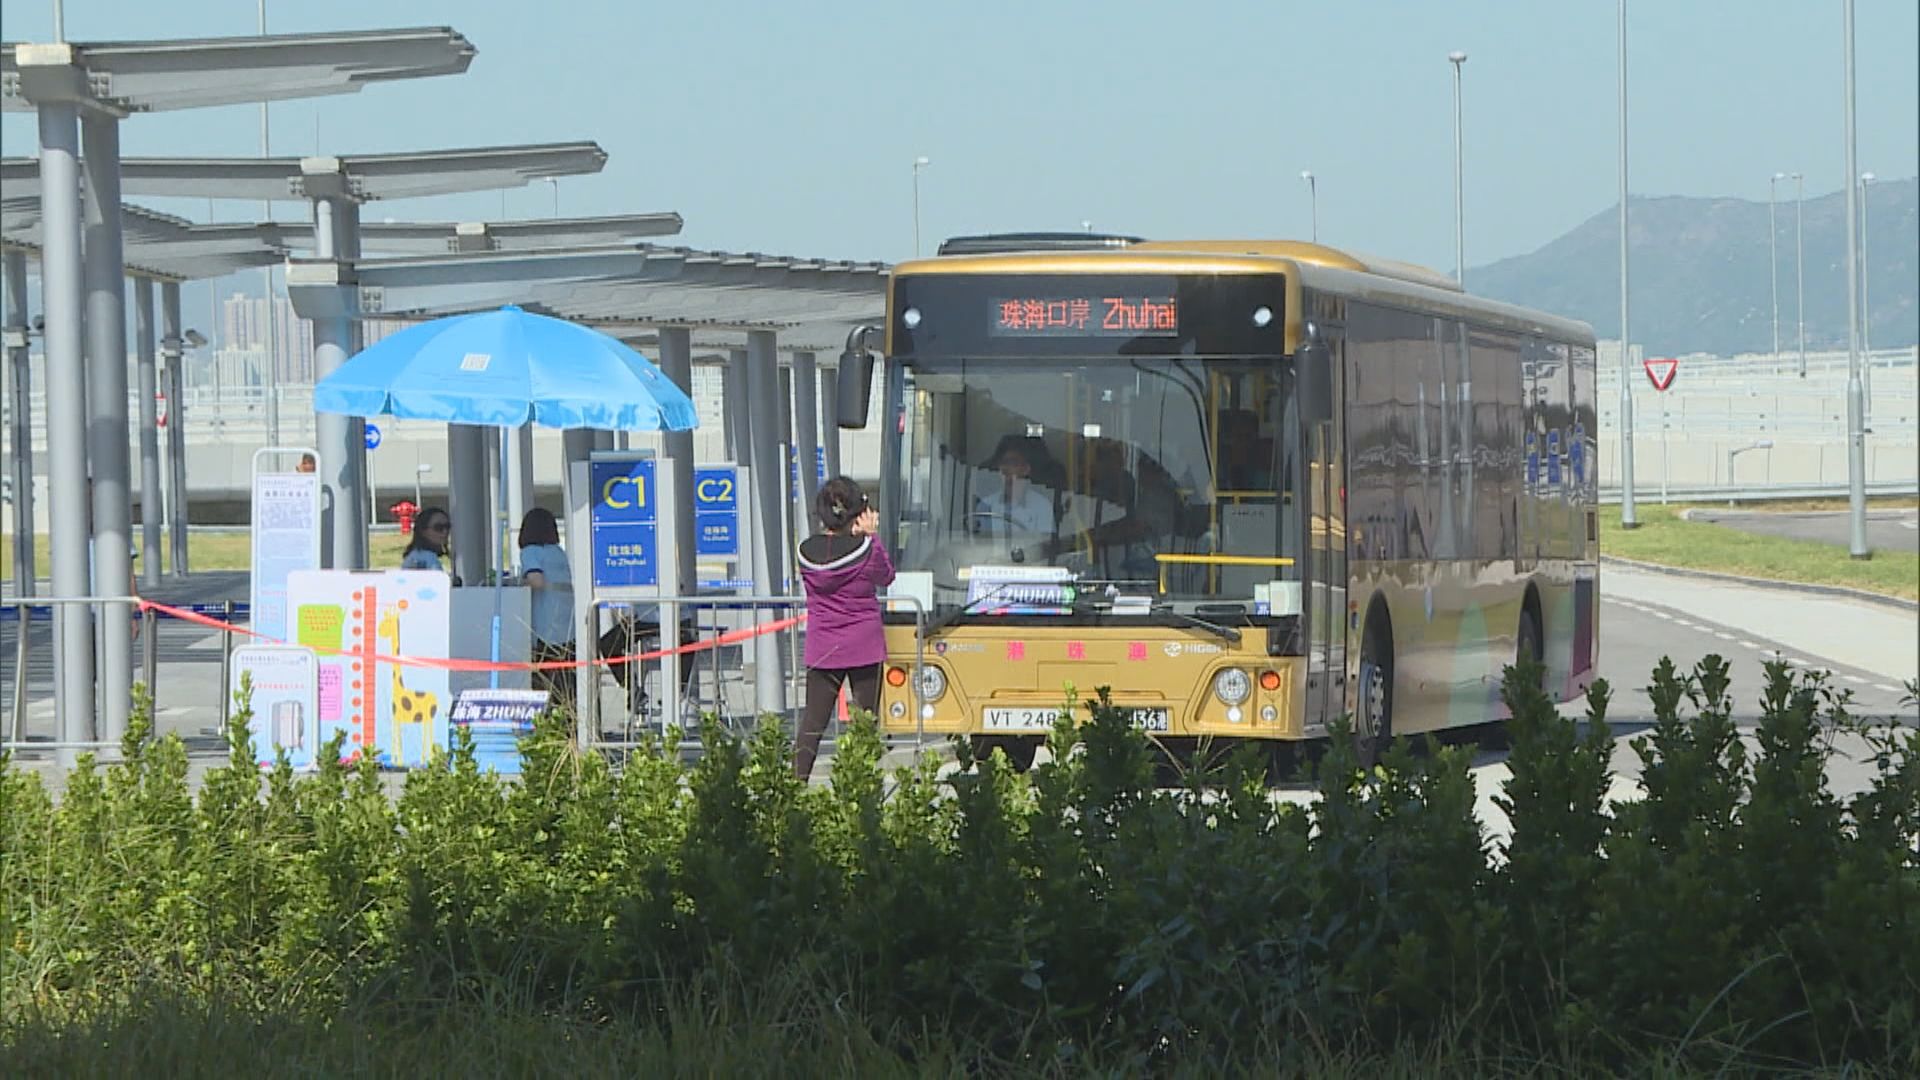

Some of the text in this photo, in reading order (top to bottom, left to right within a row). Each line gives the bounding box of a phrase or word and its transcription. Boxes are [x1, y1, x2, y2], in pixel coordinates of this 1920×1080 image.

[1000, 298, 1176, 329] 珠海口岸 Zhuhai
[603, 476, 645, 508] C1
[698, 480, 733, 501] C2
[991, 710, 1056, 728] VT 248
